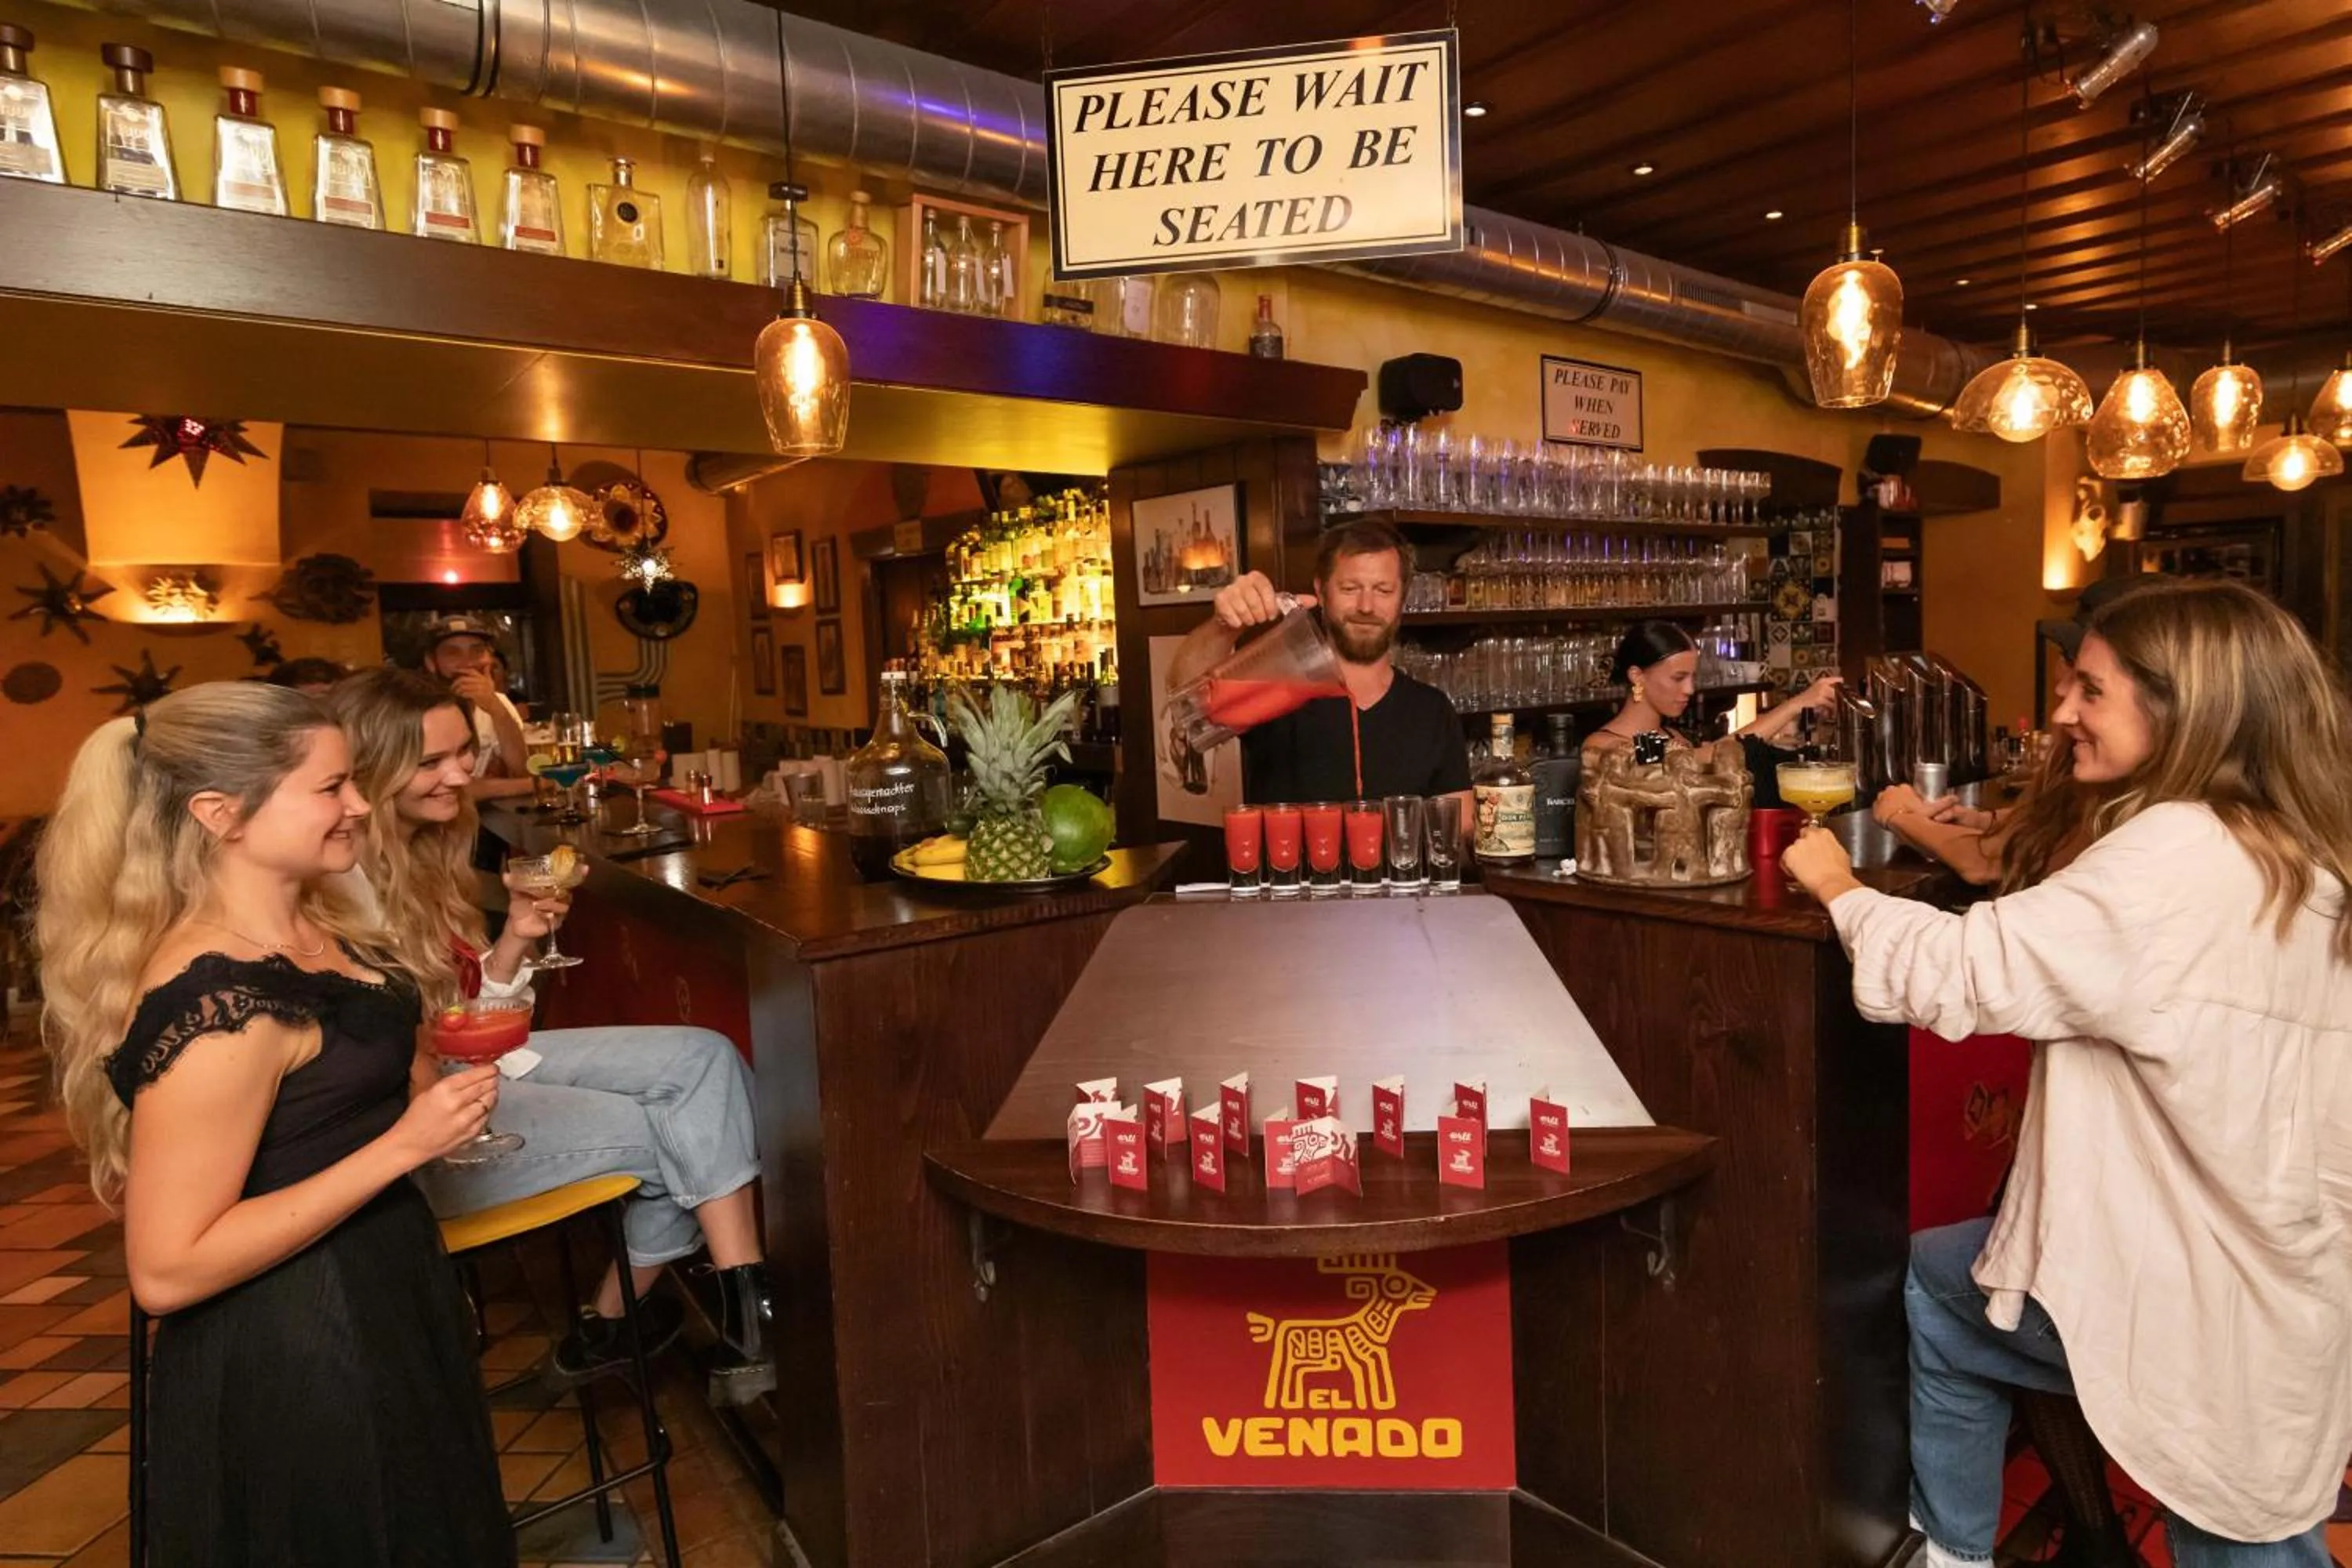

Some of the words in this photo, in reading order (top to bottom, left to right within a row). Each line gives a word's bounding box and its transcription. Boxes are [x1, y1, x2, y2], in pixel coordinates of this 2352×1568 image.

[1073, 77, 1270, 133] PLEASE
[1294, 61, 1428, 112] WAIT
[1087, 143, 1231, 191] HERE
[1254, 134, 1323, 177] TO
[1348, 125, 1417, 170] BE
[1152, 194, 1352, 247] SEATED
[1555, 368, 1606, 390] PLEASE
[1610, 377, 1633, 395] PAY
[1574, 395, 1614, 415] WHEN
[1570, 418, 1621, 439] SERVED
[1308, 1388, 1352, 1410] EL
[1202, 1417, 1462, 1458] VENADO
